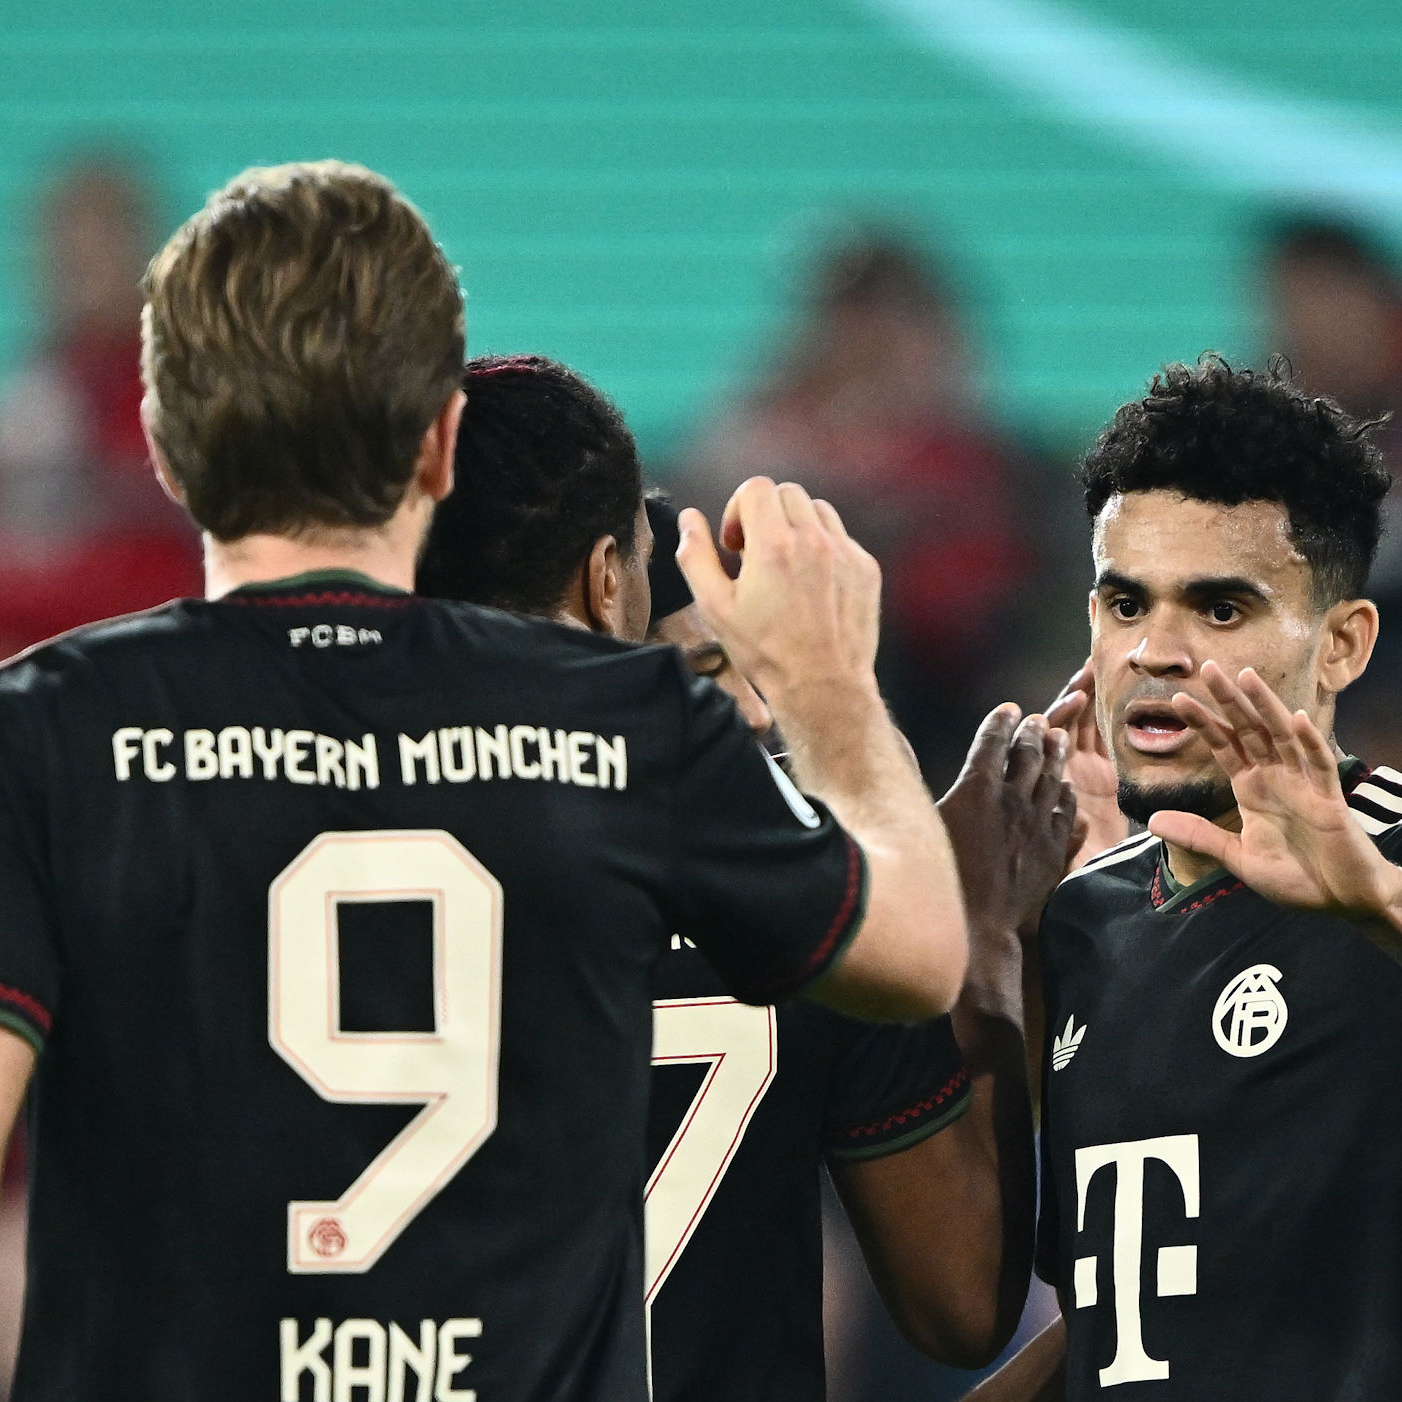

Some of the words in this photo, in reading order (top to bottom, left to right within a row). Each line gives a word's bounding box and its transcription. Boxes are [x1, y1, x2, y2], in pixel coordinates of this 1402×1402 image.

[288, 624, 383, 648] FCBM
[112, 727, 176, 782] FC
[184, 726, 380, 791] BAYERN
[397, 724, 628, 791] MÜNCHEN
[267, 828, 504, 1275] 9
[1073, 1133, 1201, 1388] T
